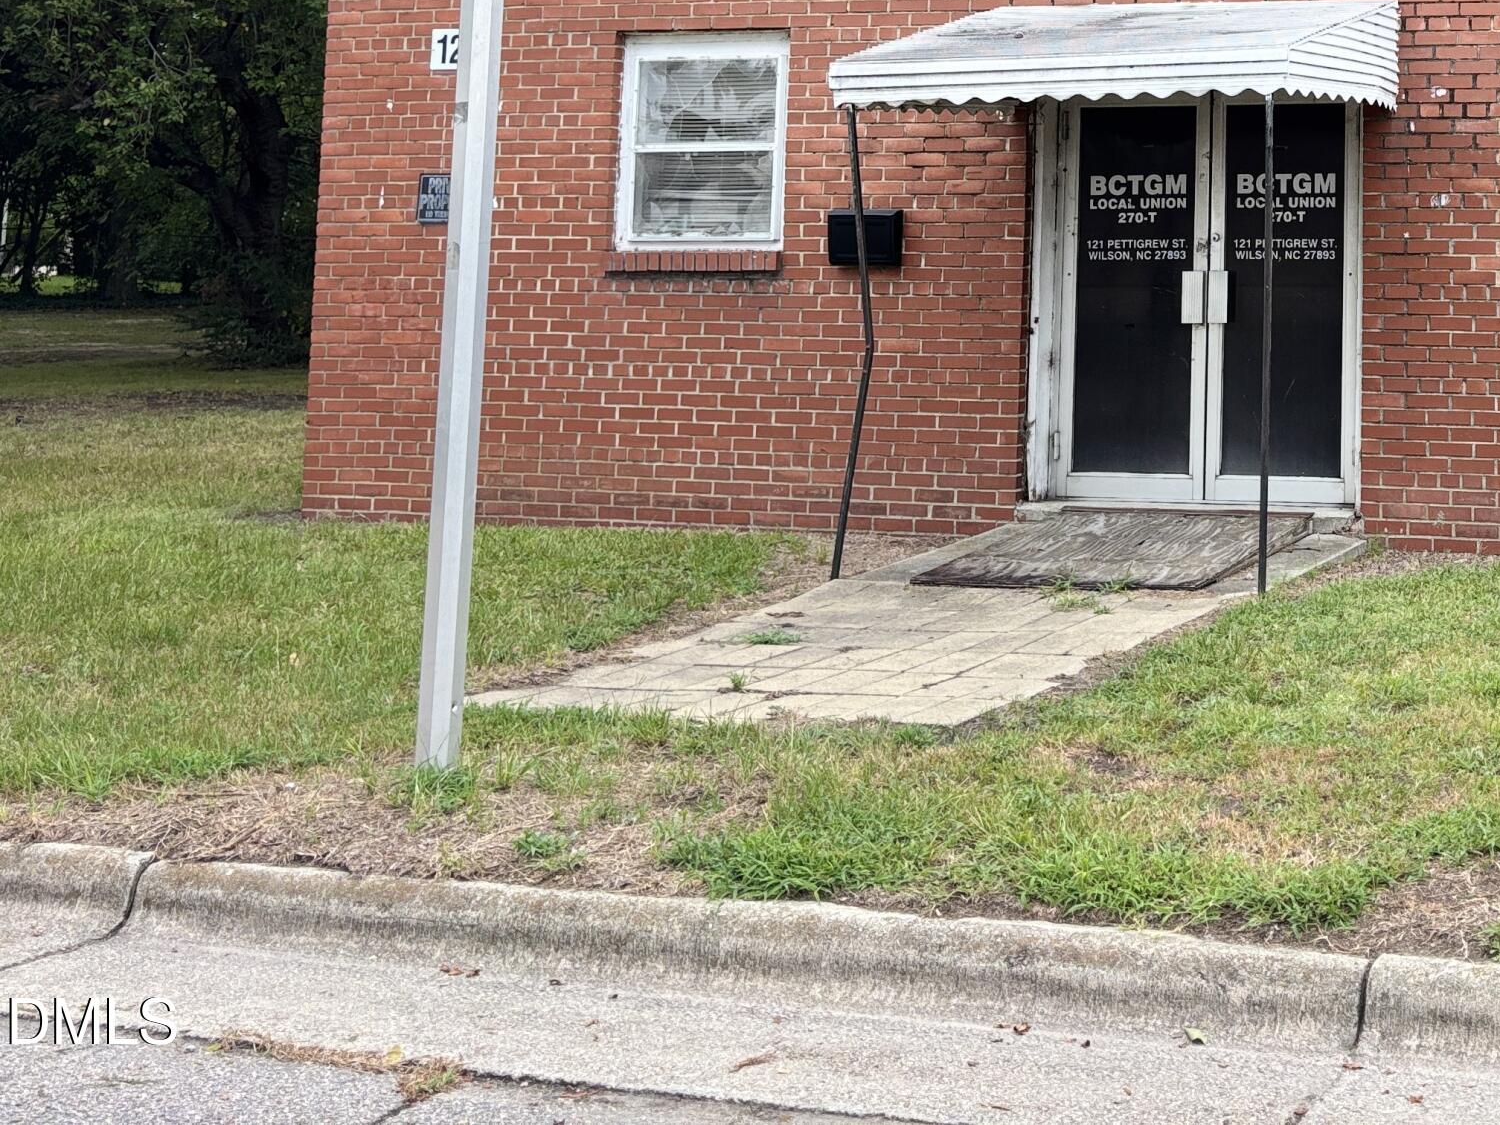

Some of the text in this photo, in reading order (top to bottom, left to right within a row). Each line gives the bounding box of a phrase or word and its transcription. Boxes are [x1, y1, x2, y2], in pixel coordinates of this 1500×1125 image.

[1090, 174, 1187, 196] BCTGM
[1089, 197, 1187, 210] LOCAL UNION
[1236, 196, 1336, 209] LOCL UNION
[1118, 211, 1158, 223] 270-T
[1086, 238, 1188, 249] 121 PETTIGREW ST.
[1233, 239, 1251, 248] 121
[1321, 238, 1338, 249] ST.
[1088, 250, 1187, 261] WILSON, NC 27893
[1284, 250, 1301, 260] NC
[1303, 250, 1336, 260] 27893
